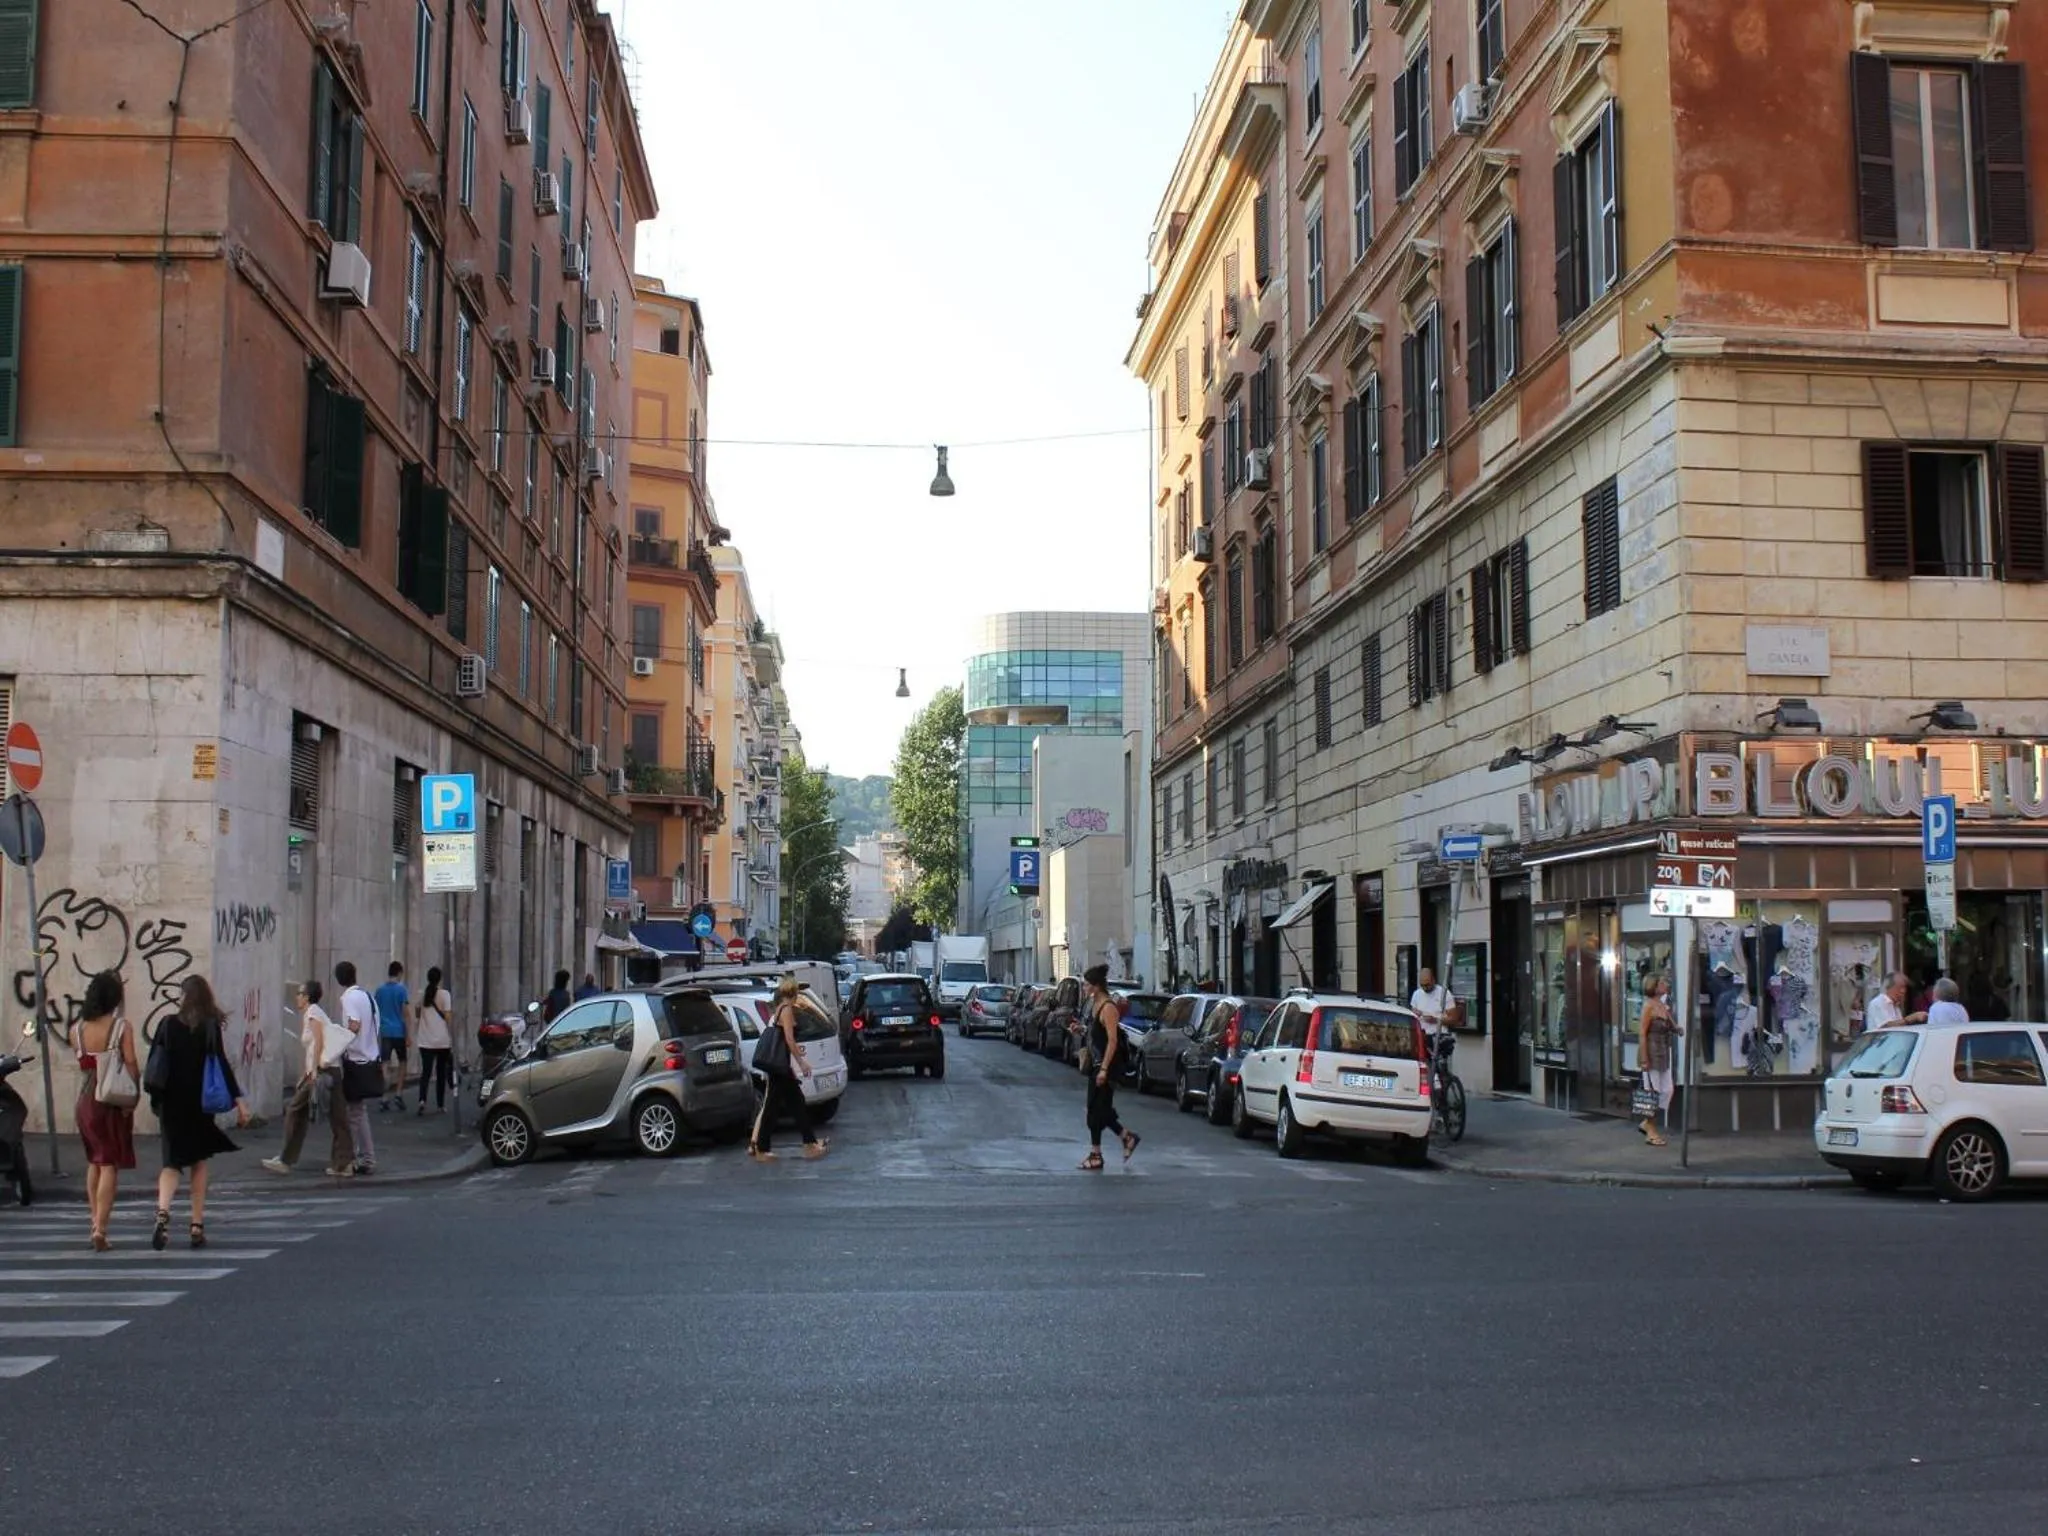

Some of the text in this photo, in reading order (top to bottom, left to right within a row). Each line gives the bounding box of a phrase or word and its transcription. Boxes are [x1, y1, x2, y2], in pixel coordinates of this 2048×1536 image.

[1696, 752, 1942, 817] BLOW
[432, 781, 462, 827] P
[456, 815, 465, 826] 7
[1928, 804, 1947, 855] P
[1681, 839, 1735, 849] musei vaticani
[612, 863, 626, 884] T
[1019, 859, 1033, 878] P
